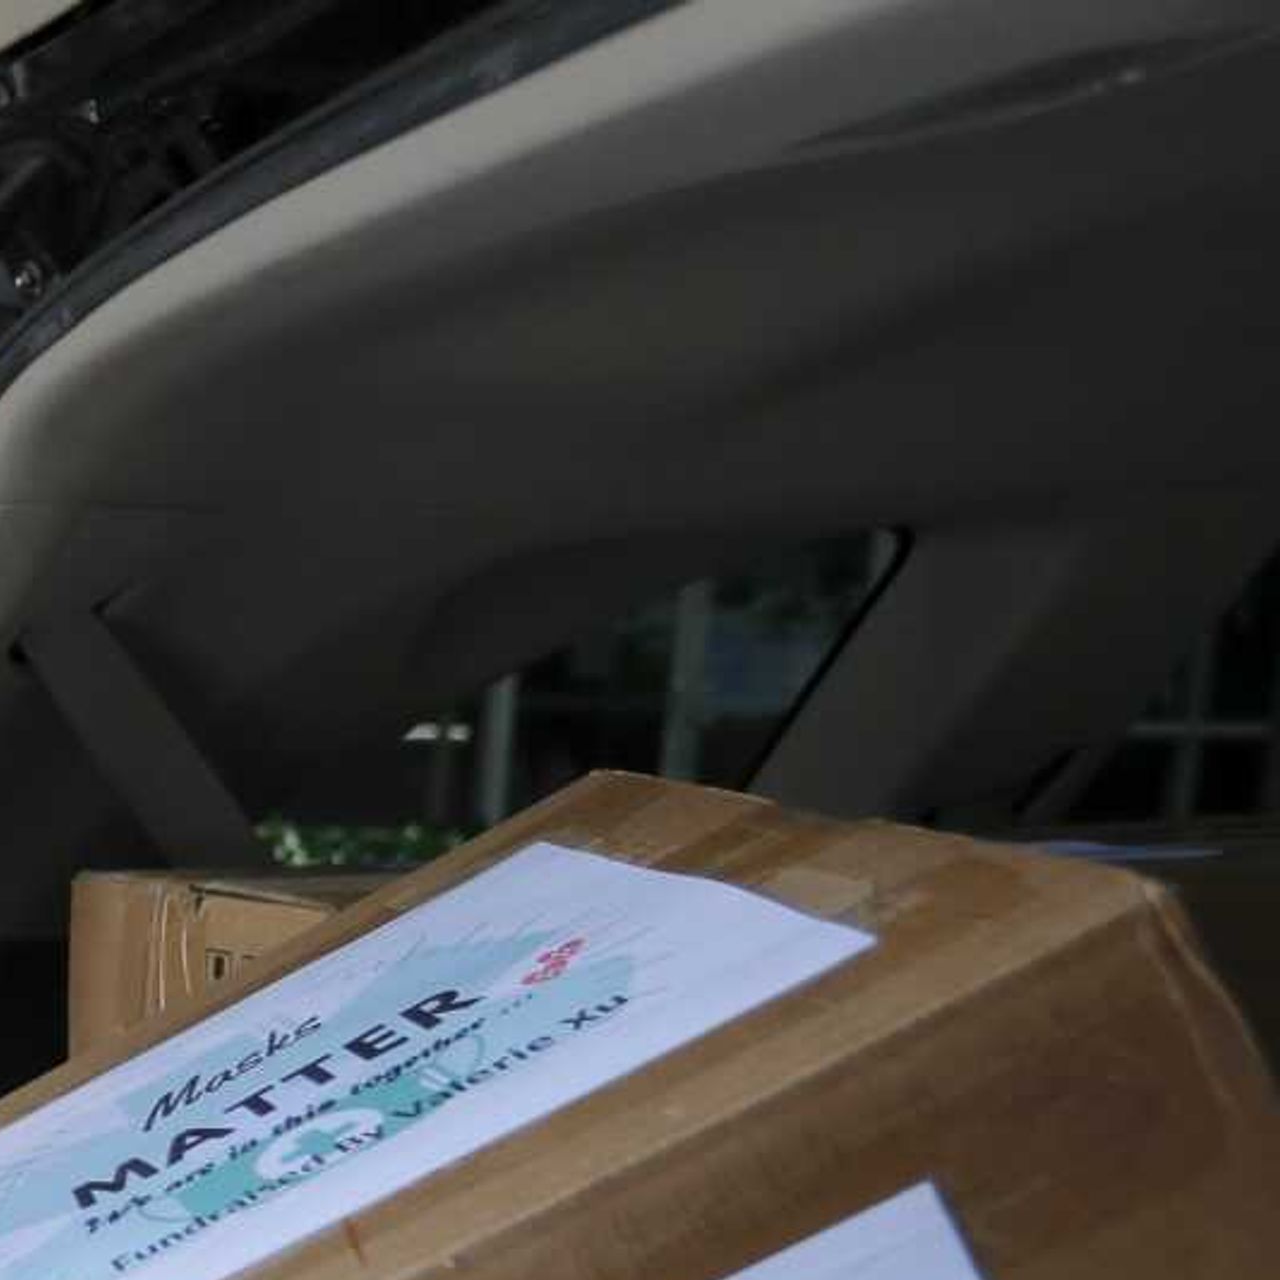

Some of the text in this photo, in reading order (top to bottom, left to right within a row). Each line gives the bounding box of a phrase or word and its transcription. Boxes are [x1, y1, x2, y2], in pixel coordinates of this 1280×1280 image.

[73, 990, 486, 1209] MATTER
[111, 995, 629, 1272] Fundraised By Valerie Xu
[143, 1015, 322, 1133] Masks
